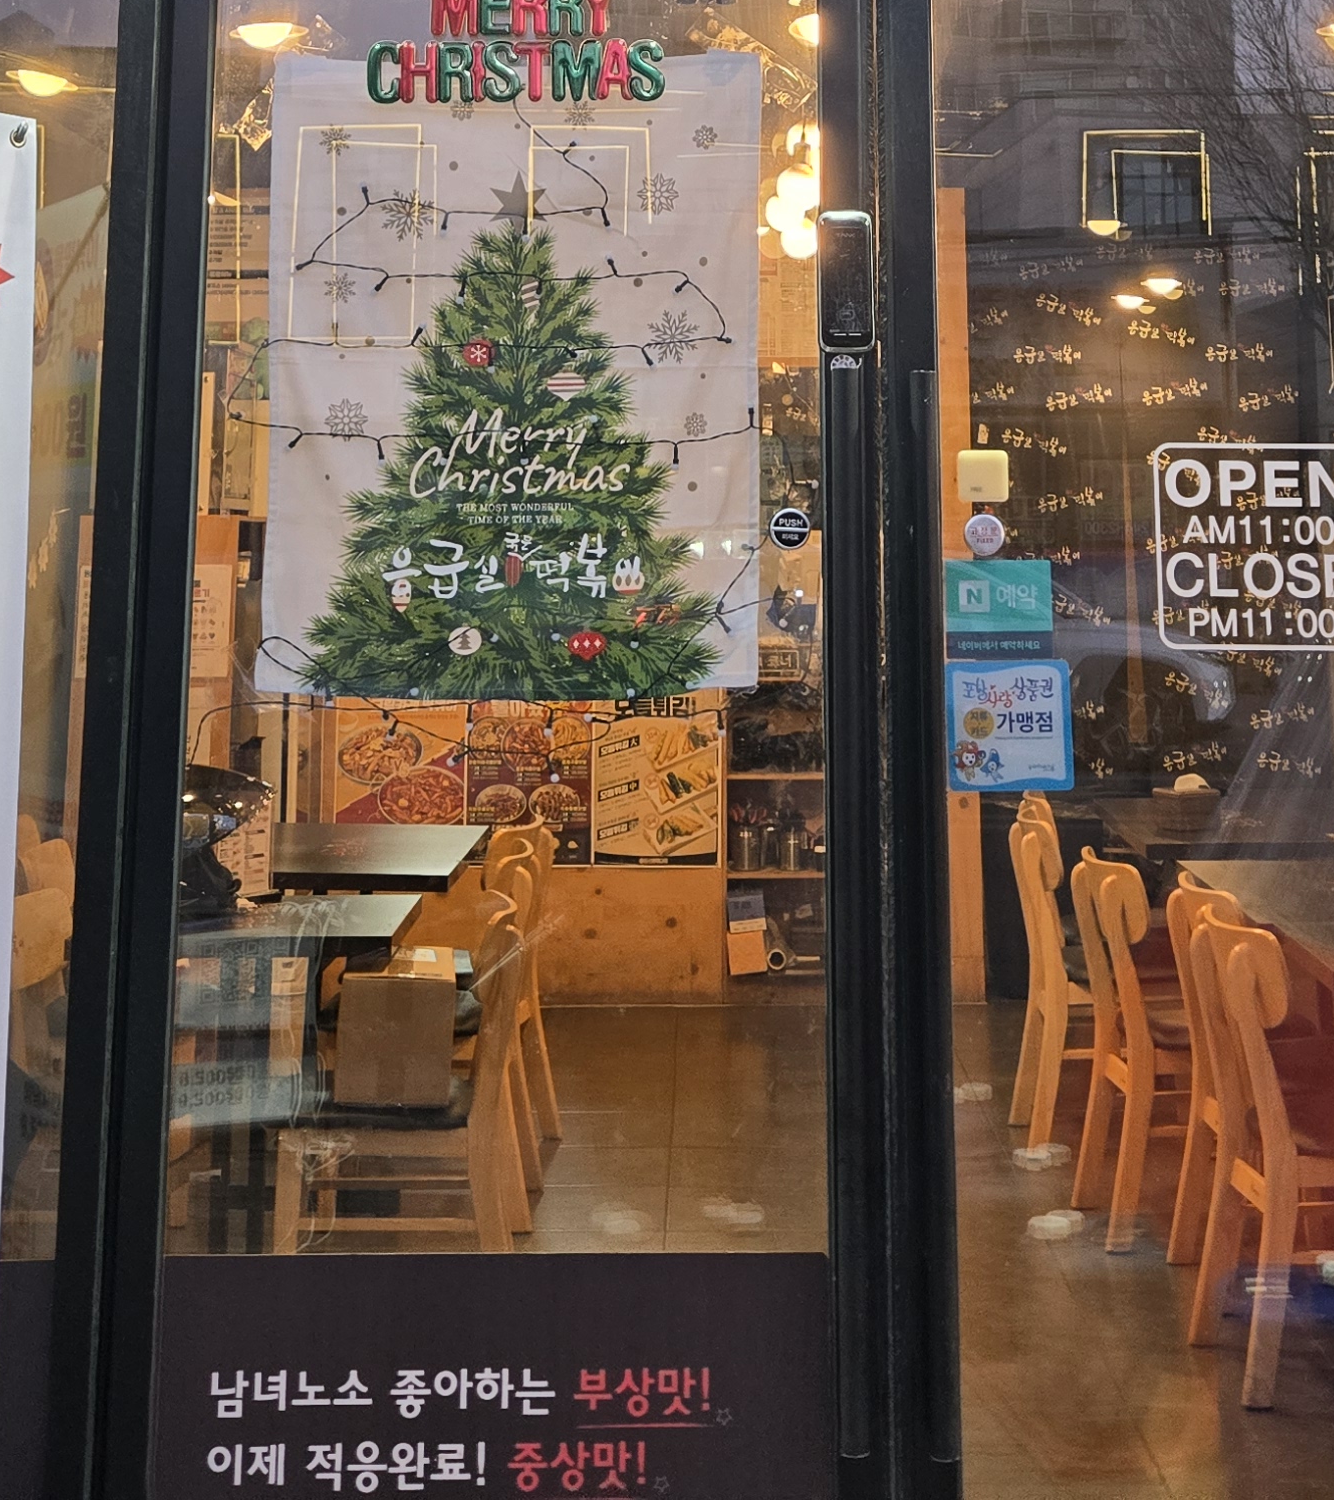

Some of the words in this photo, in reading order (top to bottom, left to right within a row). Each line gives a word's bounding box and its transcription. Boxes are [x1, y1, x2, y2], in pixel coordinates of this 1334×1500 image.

[366, 38, 666, 104] CHRISTMAS
[453, 408, 587, 469] Merry
[409, 445, 631, 498] Christmas
[456, 504, 478, 513] THE
[480, 503, 508, 512] MOST
[511, 503, 575, 512] WONDERFUL
[468, 516, 493, 524] TIME
[495, 515, 508, 524] OF
[512, 515, 533, 524] THE
[536, 515, 563, 524] YEAR
[779, 518, 803, 527] PUSH
[381, 539, 505, 600] 응급실
[996, 584, 1039, 610] 예약
[997, 710, 1053, 733] 가맹점
[208, 1369, 374, 1419] 남녀노소
[389, 1367, 556, 1419] 좋아하는
[573, 1367, 712, 1417] 부상맛!
[207, 1443, 286, 1487] 이제
[305, 1440, 487, 1494] 적응완료!
[507, 1441, 647, 1493] 중상맛!
